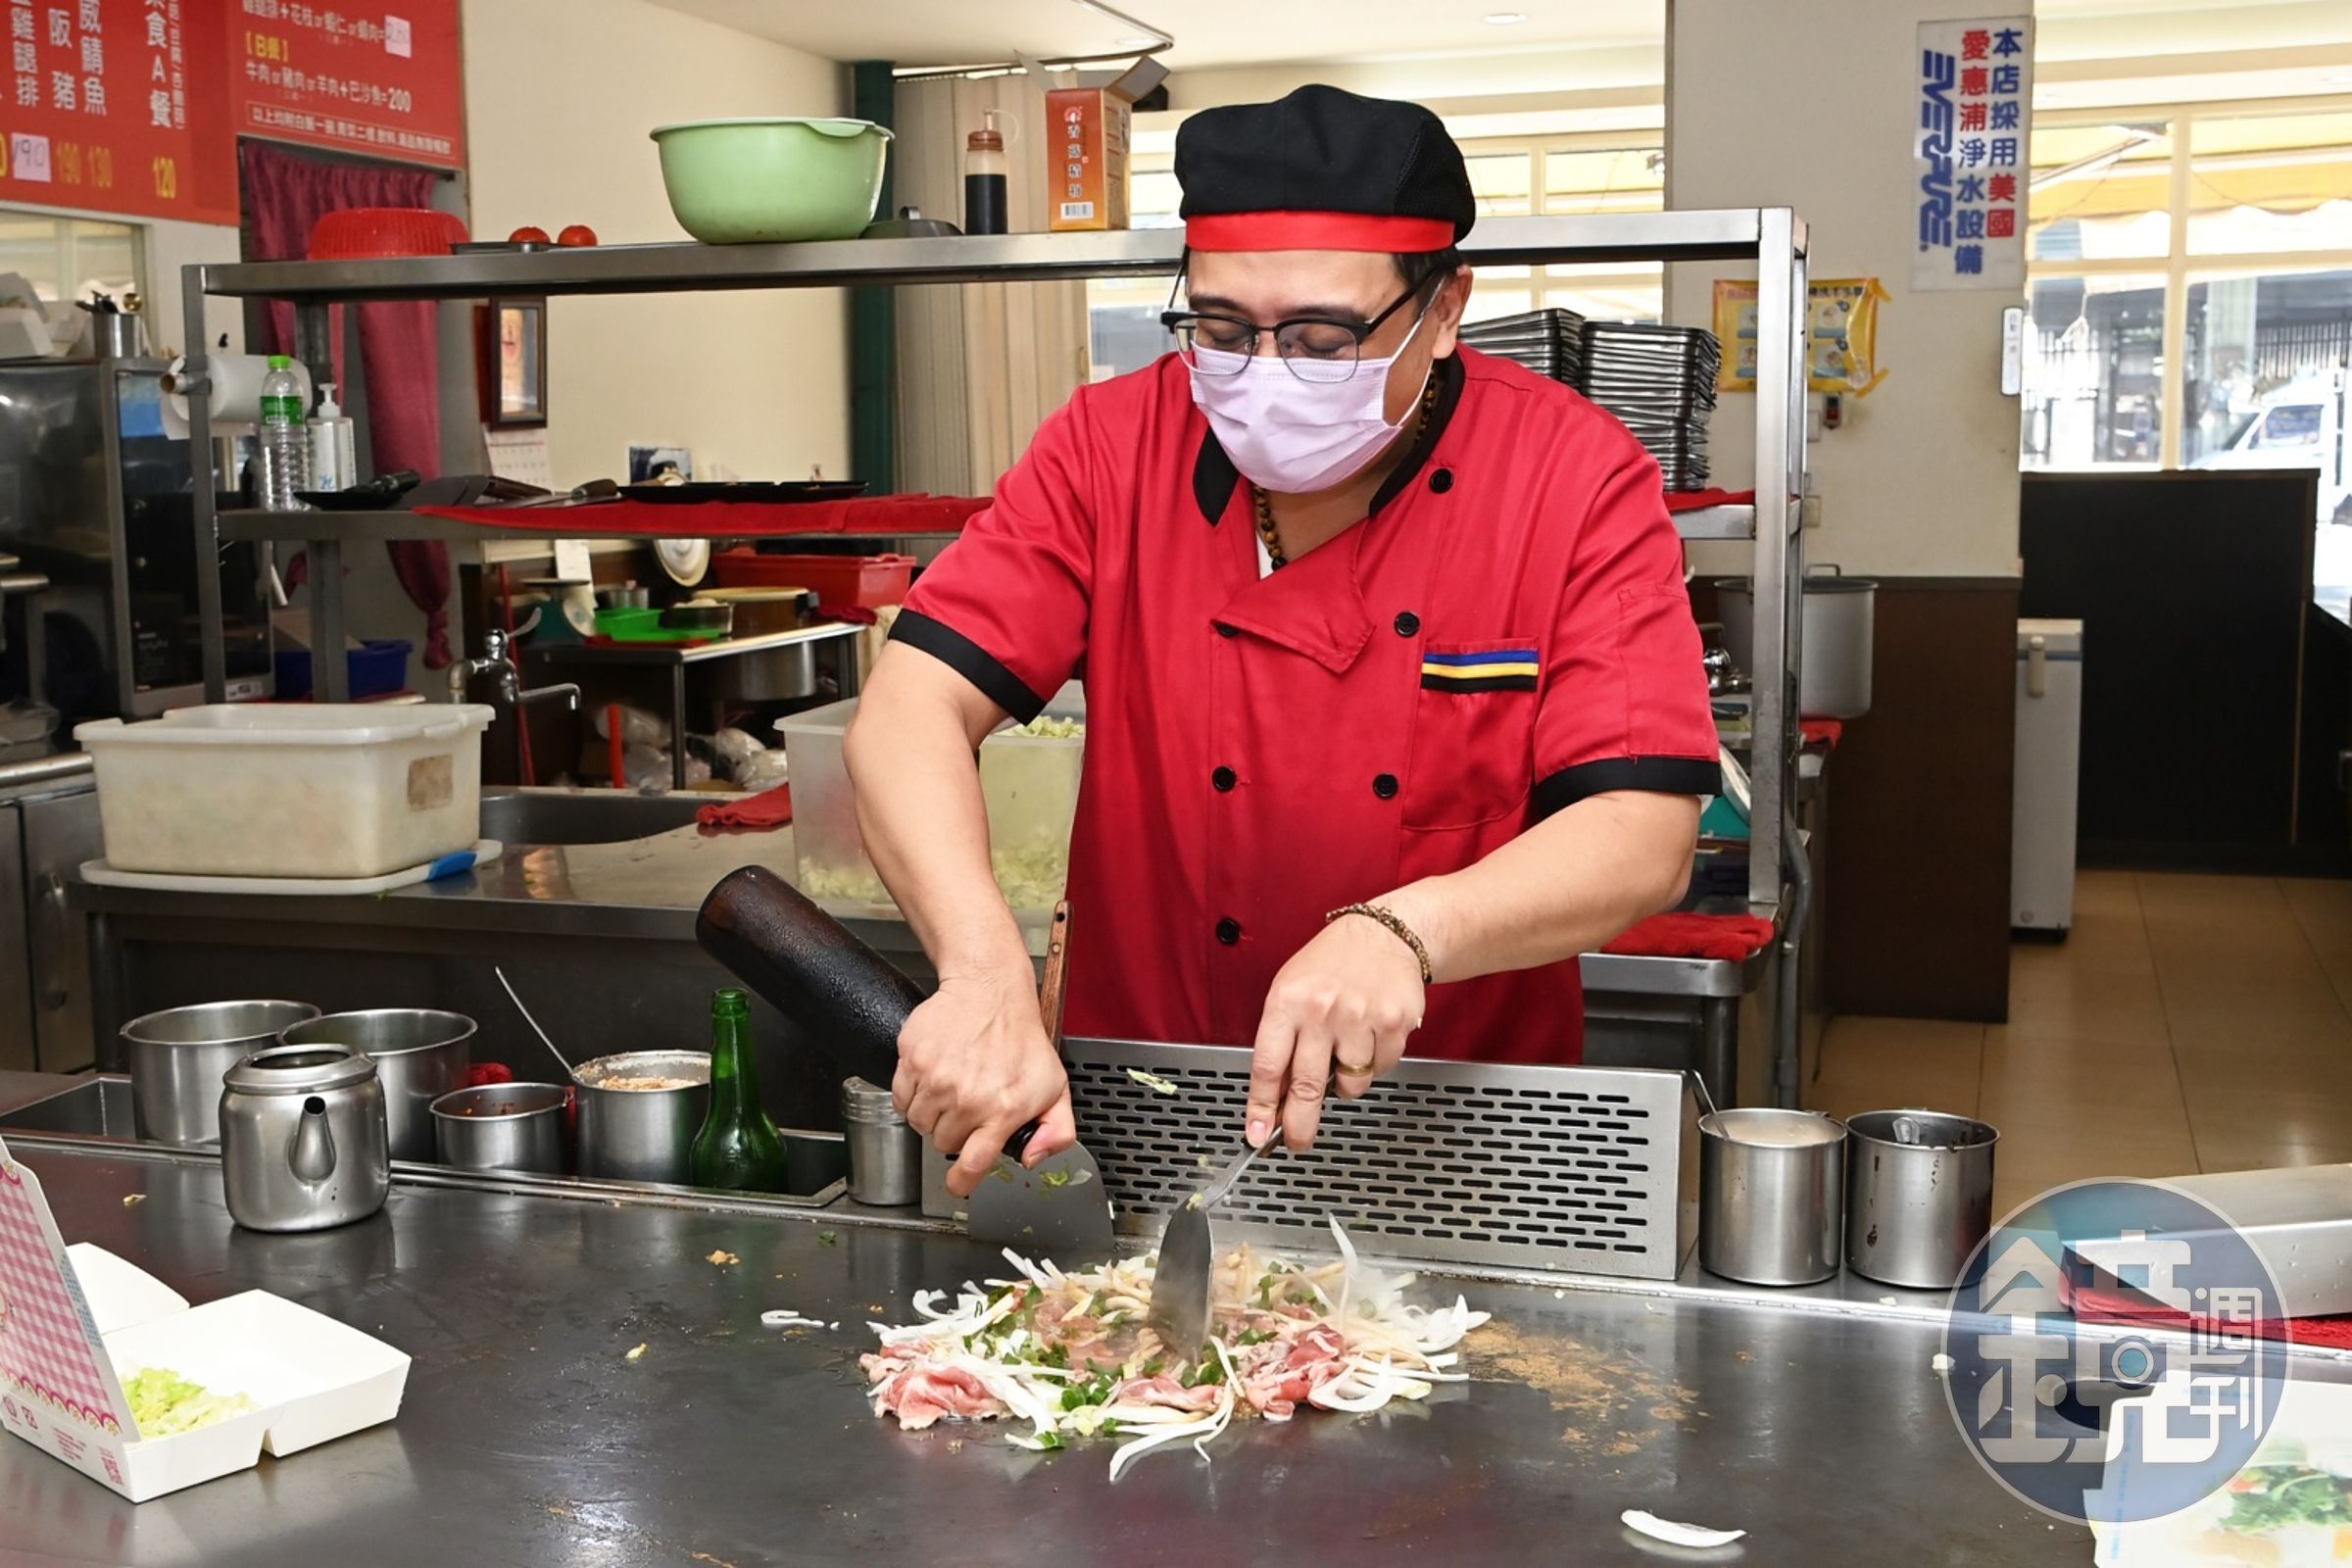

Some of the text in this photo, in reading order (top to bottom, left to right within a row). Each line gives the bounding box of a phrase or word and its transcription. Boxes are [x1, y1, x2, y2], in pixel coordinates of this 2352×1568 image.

[8, 0, 39, 108] 雞腿排
[144, 0, 172, 128] 食A餐
[153, 156, 176, 200] 120
[1954, 30, 1990, 274] 愛惠浦淨水設備
[1987, 28, 2023, 238] 本店採用美國
